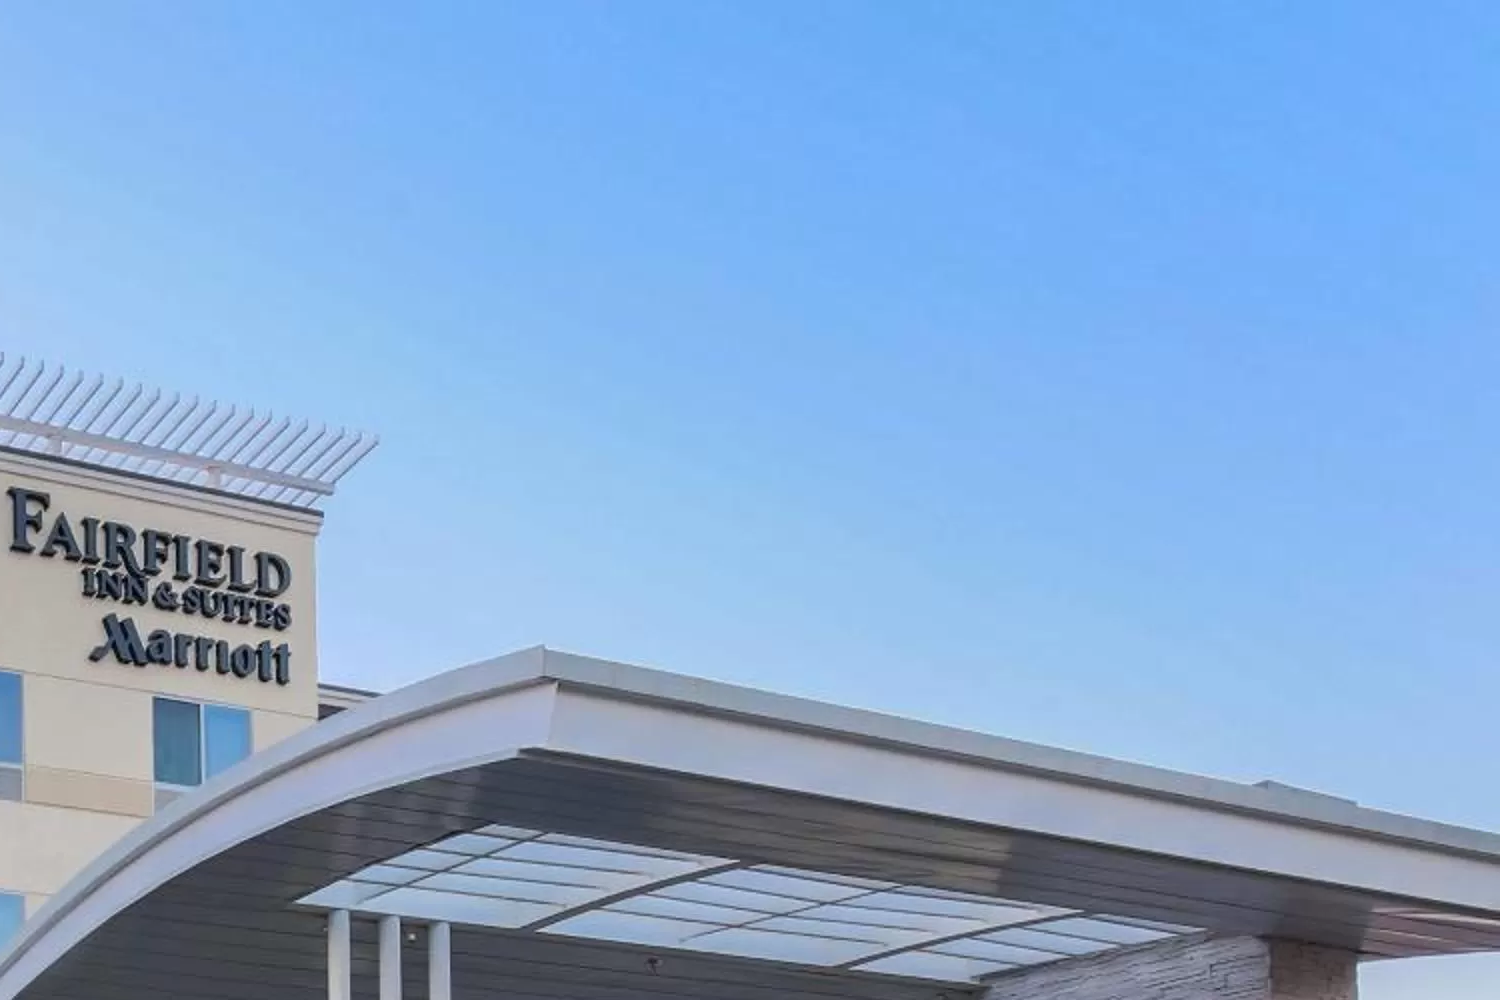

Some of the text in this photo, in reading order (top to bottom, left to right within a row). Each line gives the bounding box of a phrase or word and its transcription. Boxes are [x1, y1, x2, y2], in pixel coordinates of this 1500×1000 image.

[6, 486, 293, 599] FAIRFIELD
[81, 567, 293, 631] INN & SUITES
[88, 612, 292, 686] Marriott
